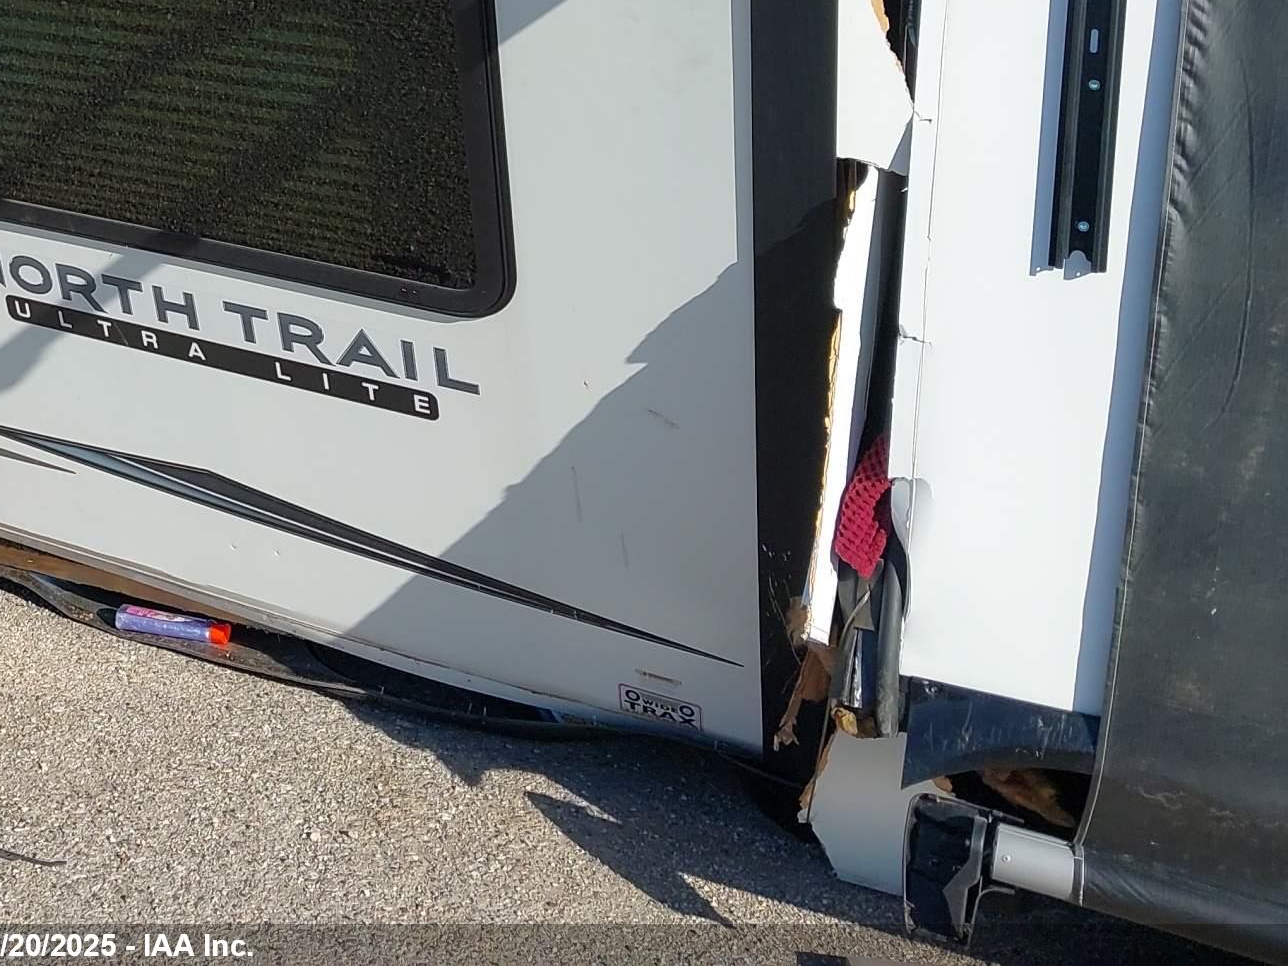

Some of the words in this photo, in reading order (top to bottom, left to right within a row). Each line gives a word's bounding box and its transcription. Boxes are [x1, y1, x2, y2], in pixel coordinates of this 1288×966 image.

[14, 300, 208, 362] ULTRA
[275, 361, 431, 416] LITE
[222, 300, 481, 395] TRAIL
[623, 699, 699, 730] TRAX
